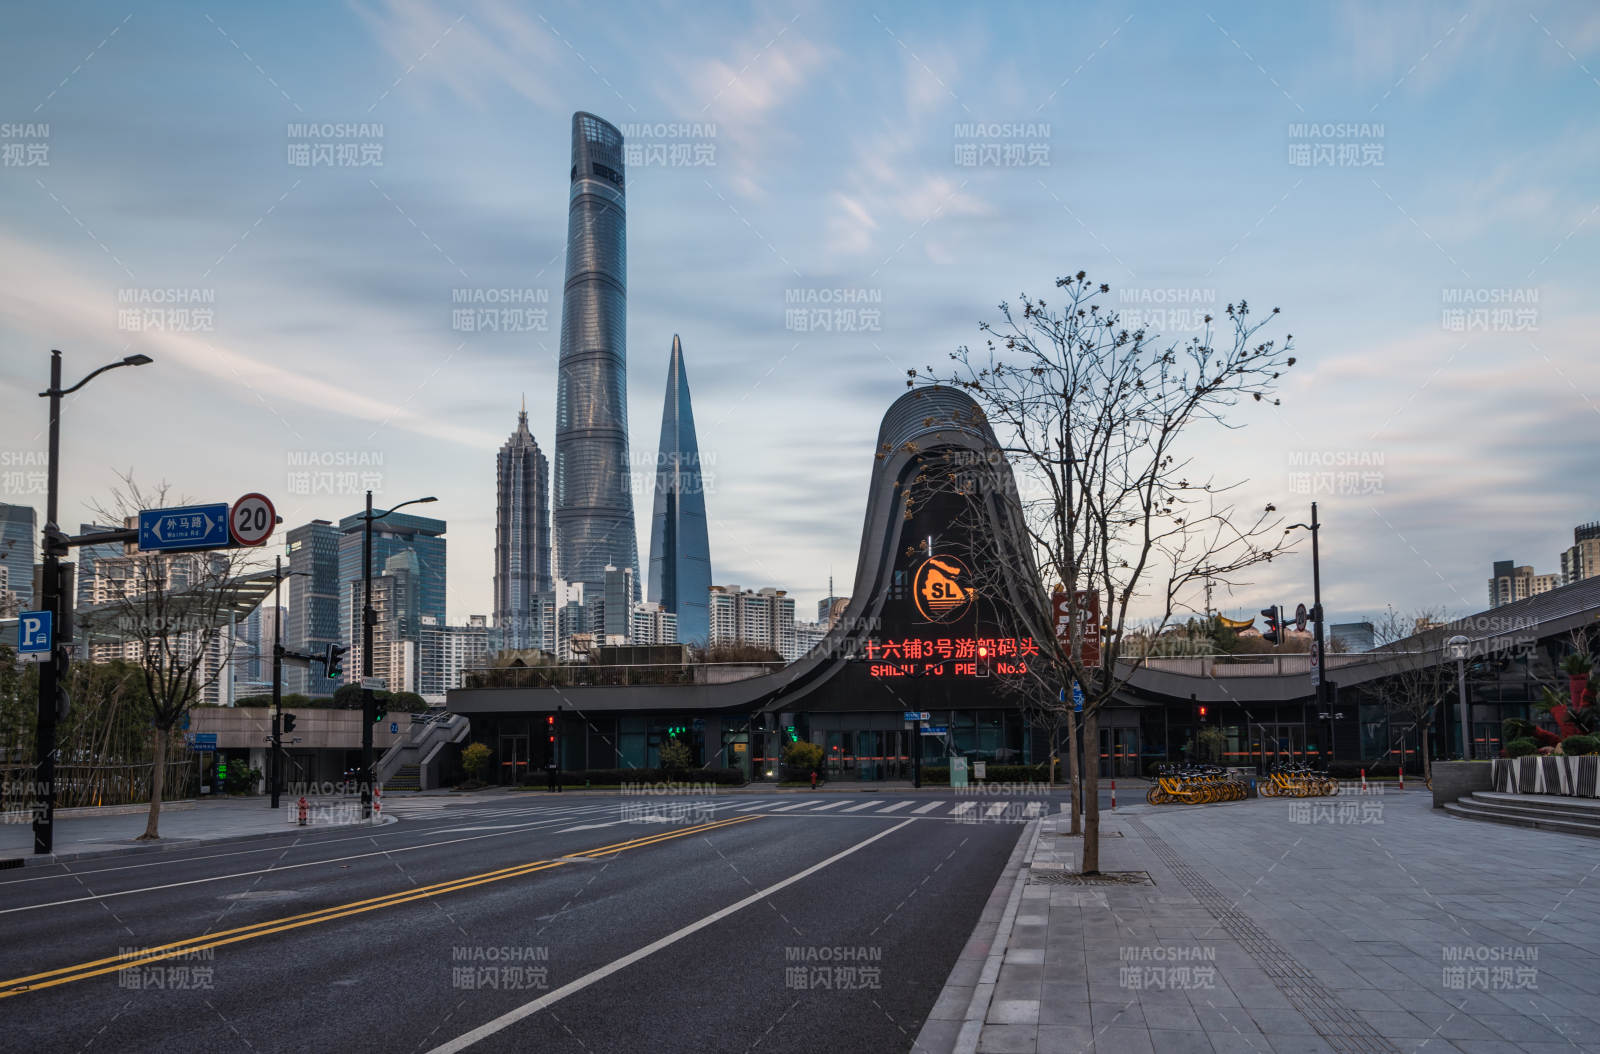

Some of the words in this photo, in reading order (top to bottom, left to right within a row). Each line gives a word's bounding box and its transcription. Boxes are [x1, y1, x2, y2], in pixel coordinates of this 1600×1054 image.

[167, 516, 202, 530] 外马路
[239, 507, 267, 532] 20
[931, 582, 957, 599] SL
[22, 617, 41, 646] P
[925, 664, 944, 676] PU
[954, 665, 977, 675] PIE
[997, 663, 1027, 674] No.3
